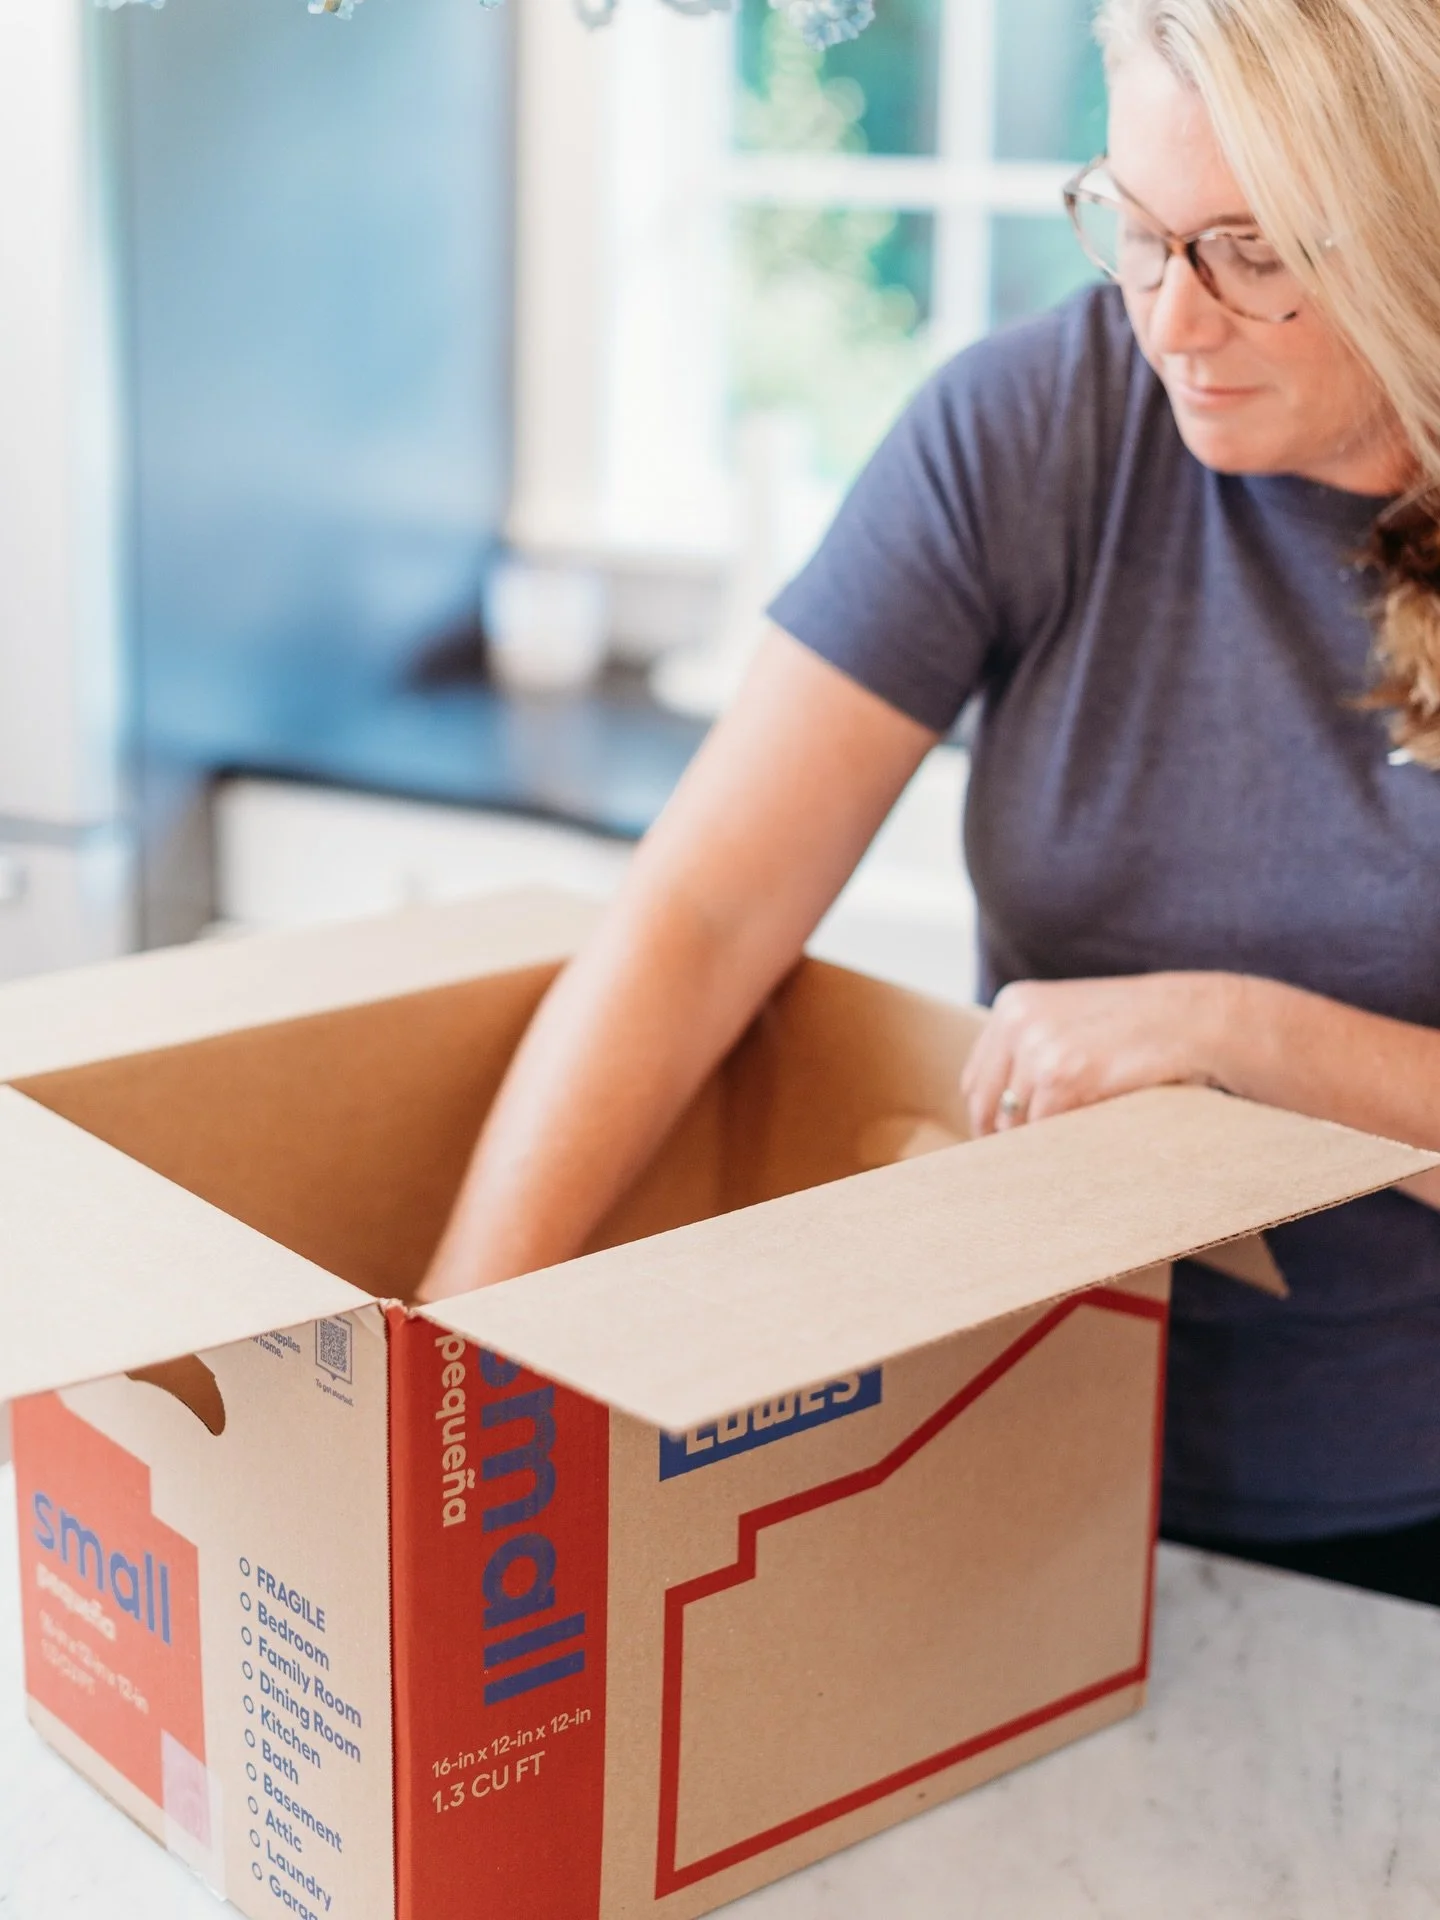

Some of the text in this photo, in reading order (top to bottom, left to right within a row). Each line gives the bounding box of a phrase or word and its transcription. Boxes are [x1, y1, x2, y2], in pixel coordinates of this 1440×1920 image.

[434, 1332, 476, 1528] pequeña
[33, 1489, 172, 1648] small
[256, 1565, 326, 1633] FRAGILE
[257, 1600, 330, 1671] Bedroom
[258, 1635, 362, 1729] Family Room
[259, 1670, 361, 1763] Dining Room
[260, 1704, 321, 1769] Kitchen
[262, 1738, 299, 1785] Bath
[431, 1707, 591, 1778] 16-in x 12-in x 12-in
[263, 1772, 343, 1853] Basement
[431, 1750, 546, 1813] 1.3 CU FT
[265, 1808, 303, 1853] Attic
[267, 1839, 332, 1912] Laundry
[269, 1874, 319, 1920] Gara
